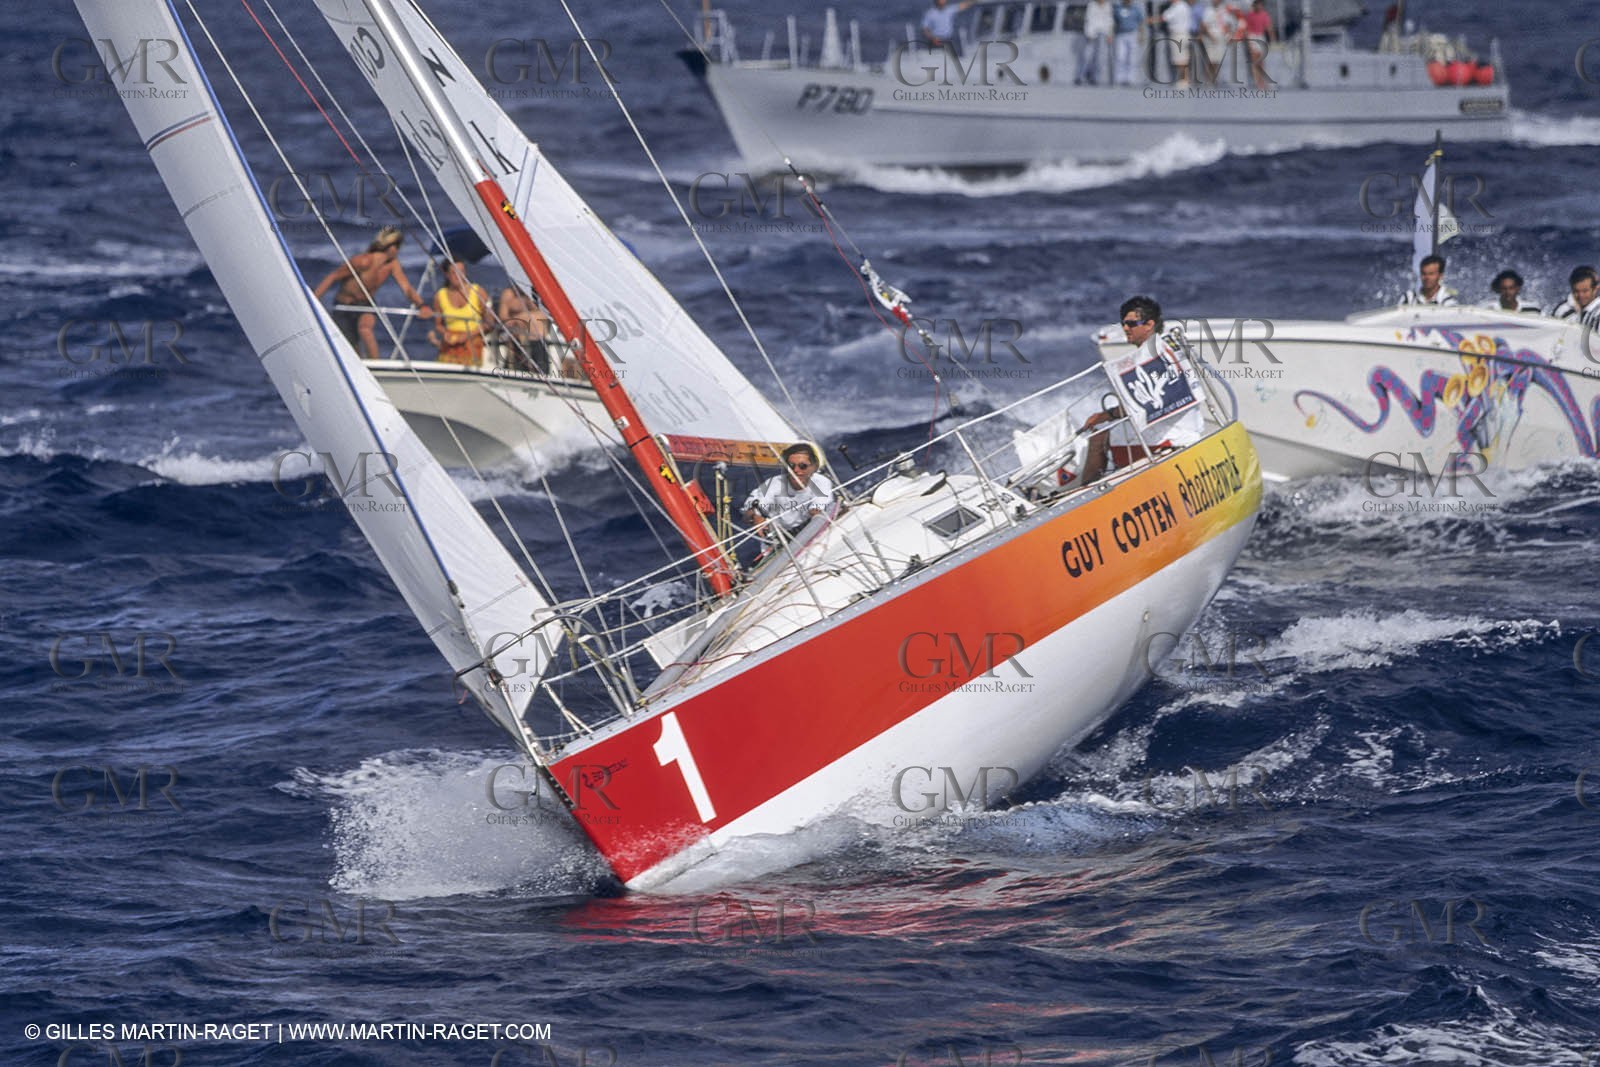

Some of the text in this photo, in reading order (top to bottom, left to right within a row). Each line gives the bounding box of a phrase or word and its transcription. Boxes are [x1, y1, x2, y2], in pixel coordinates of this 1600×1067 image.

[1061, 528, 1104, 578] GUY
[1111, 491, 1178, 553] COTTEN
[653, 711, 717, 824] 1
